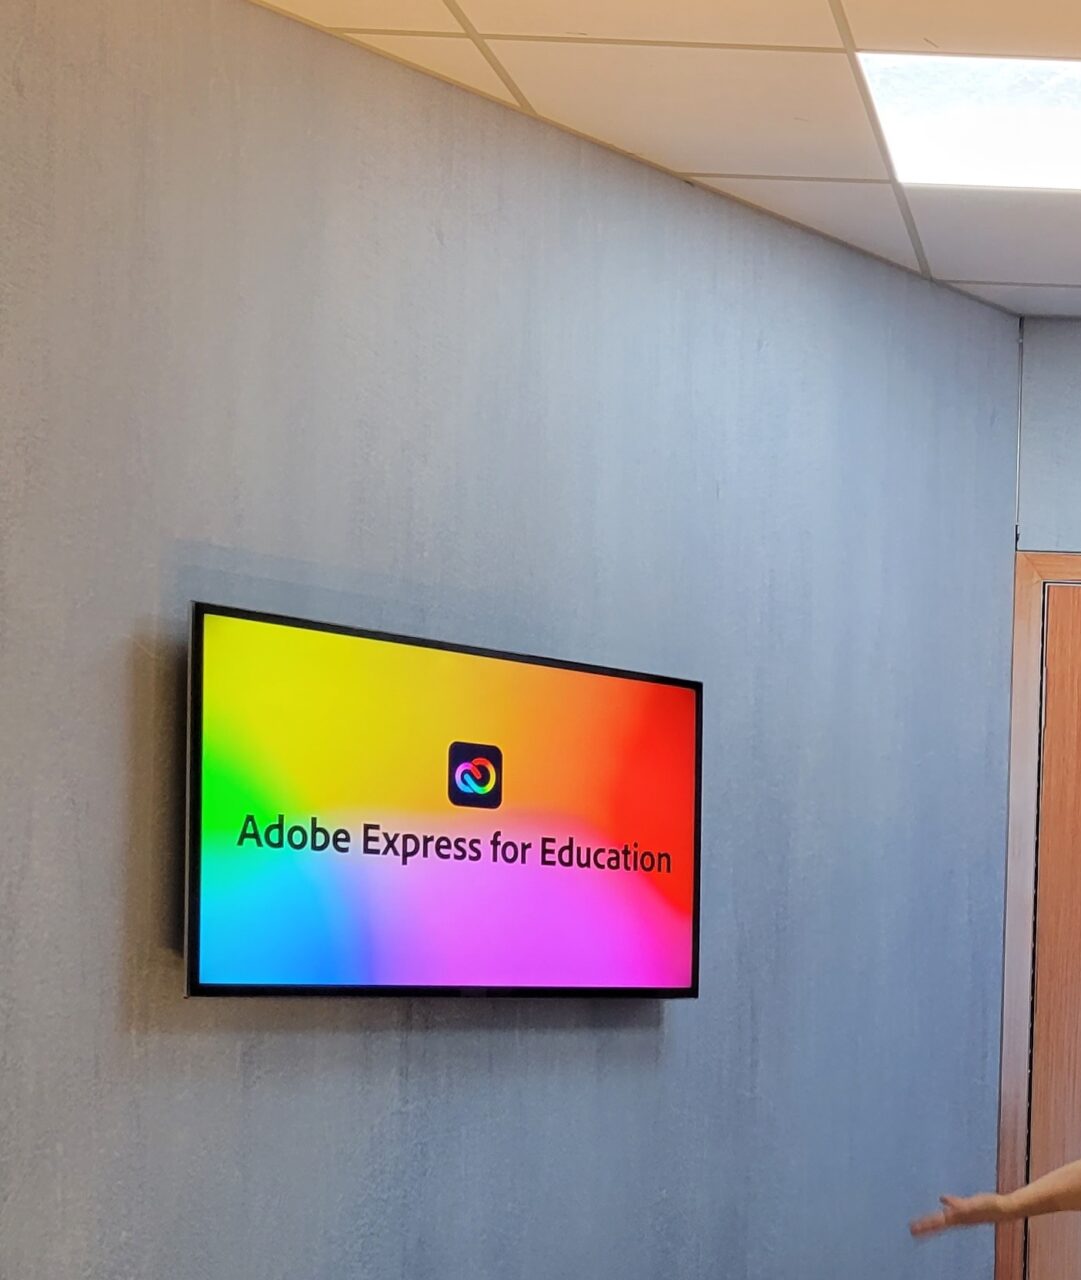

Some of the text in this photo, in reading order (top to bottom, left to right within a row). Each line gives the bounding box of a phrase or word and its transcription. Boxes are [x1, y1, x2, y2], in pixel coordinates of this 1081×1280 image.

[236, 814, 673, 874] Adobe Express for Education
